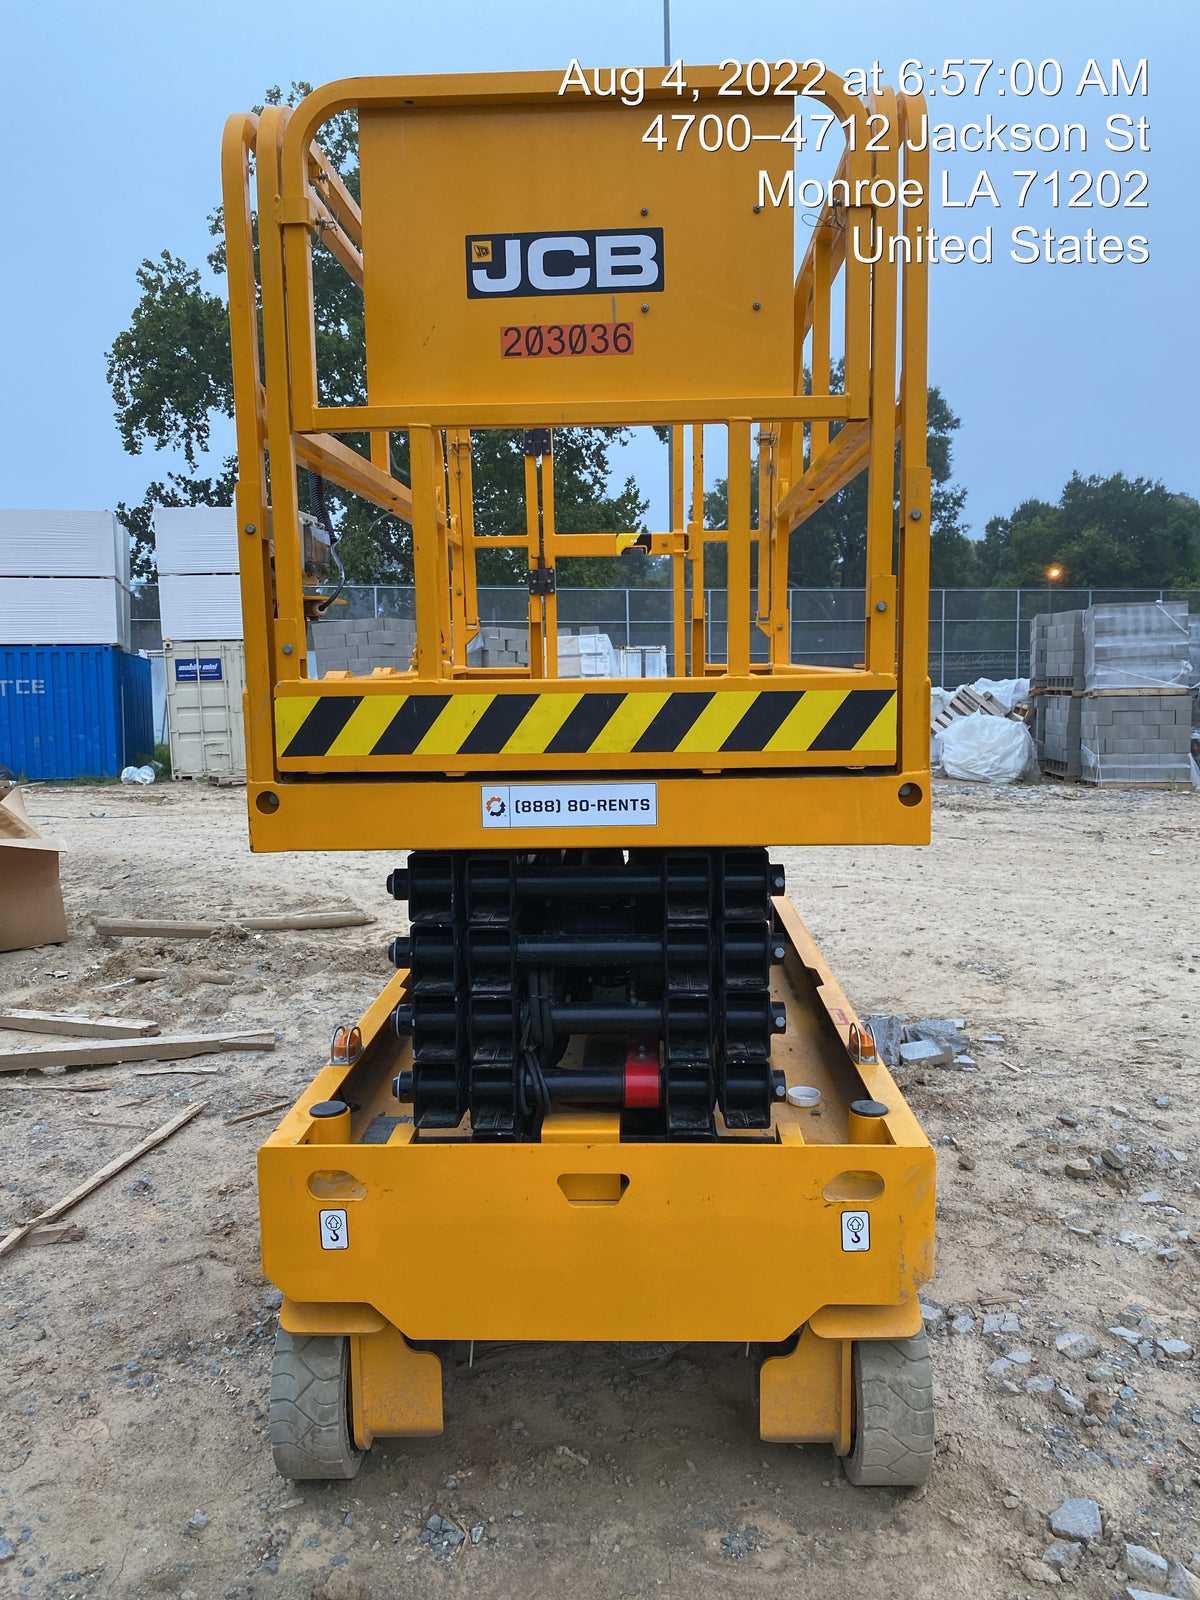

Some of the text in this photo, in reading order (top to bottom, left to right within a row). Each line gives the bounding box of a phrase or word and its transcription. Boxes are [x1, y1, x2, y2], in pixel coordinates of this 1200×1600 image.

[471, 234, 659, 293] JCB
[503, 322, 632, 357] 203036
[515, 798, 650, 814] (888) 80-RENTS
